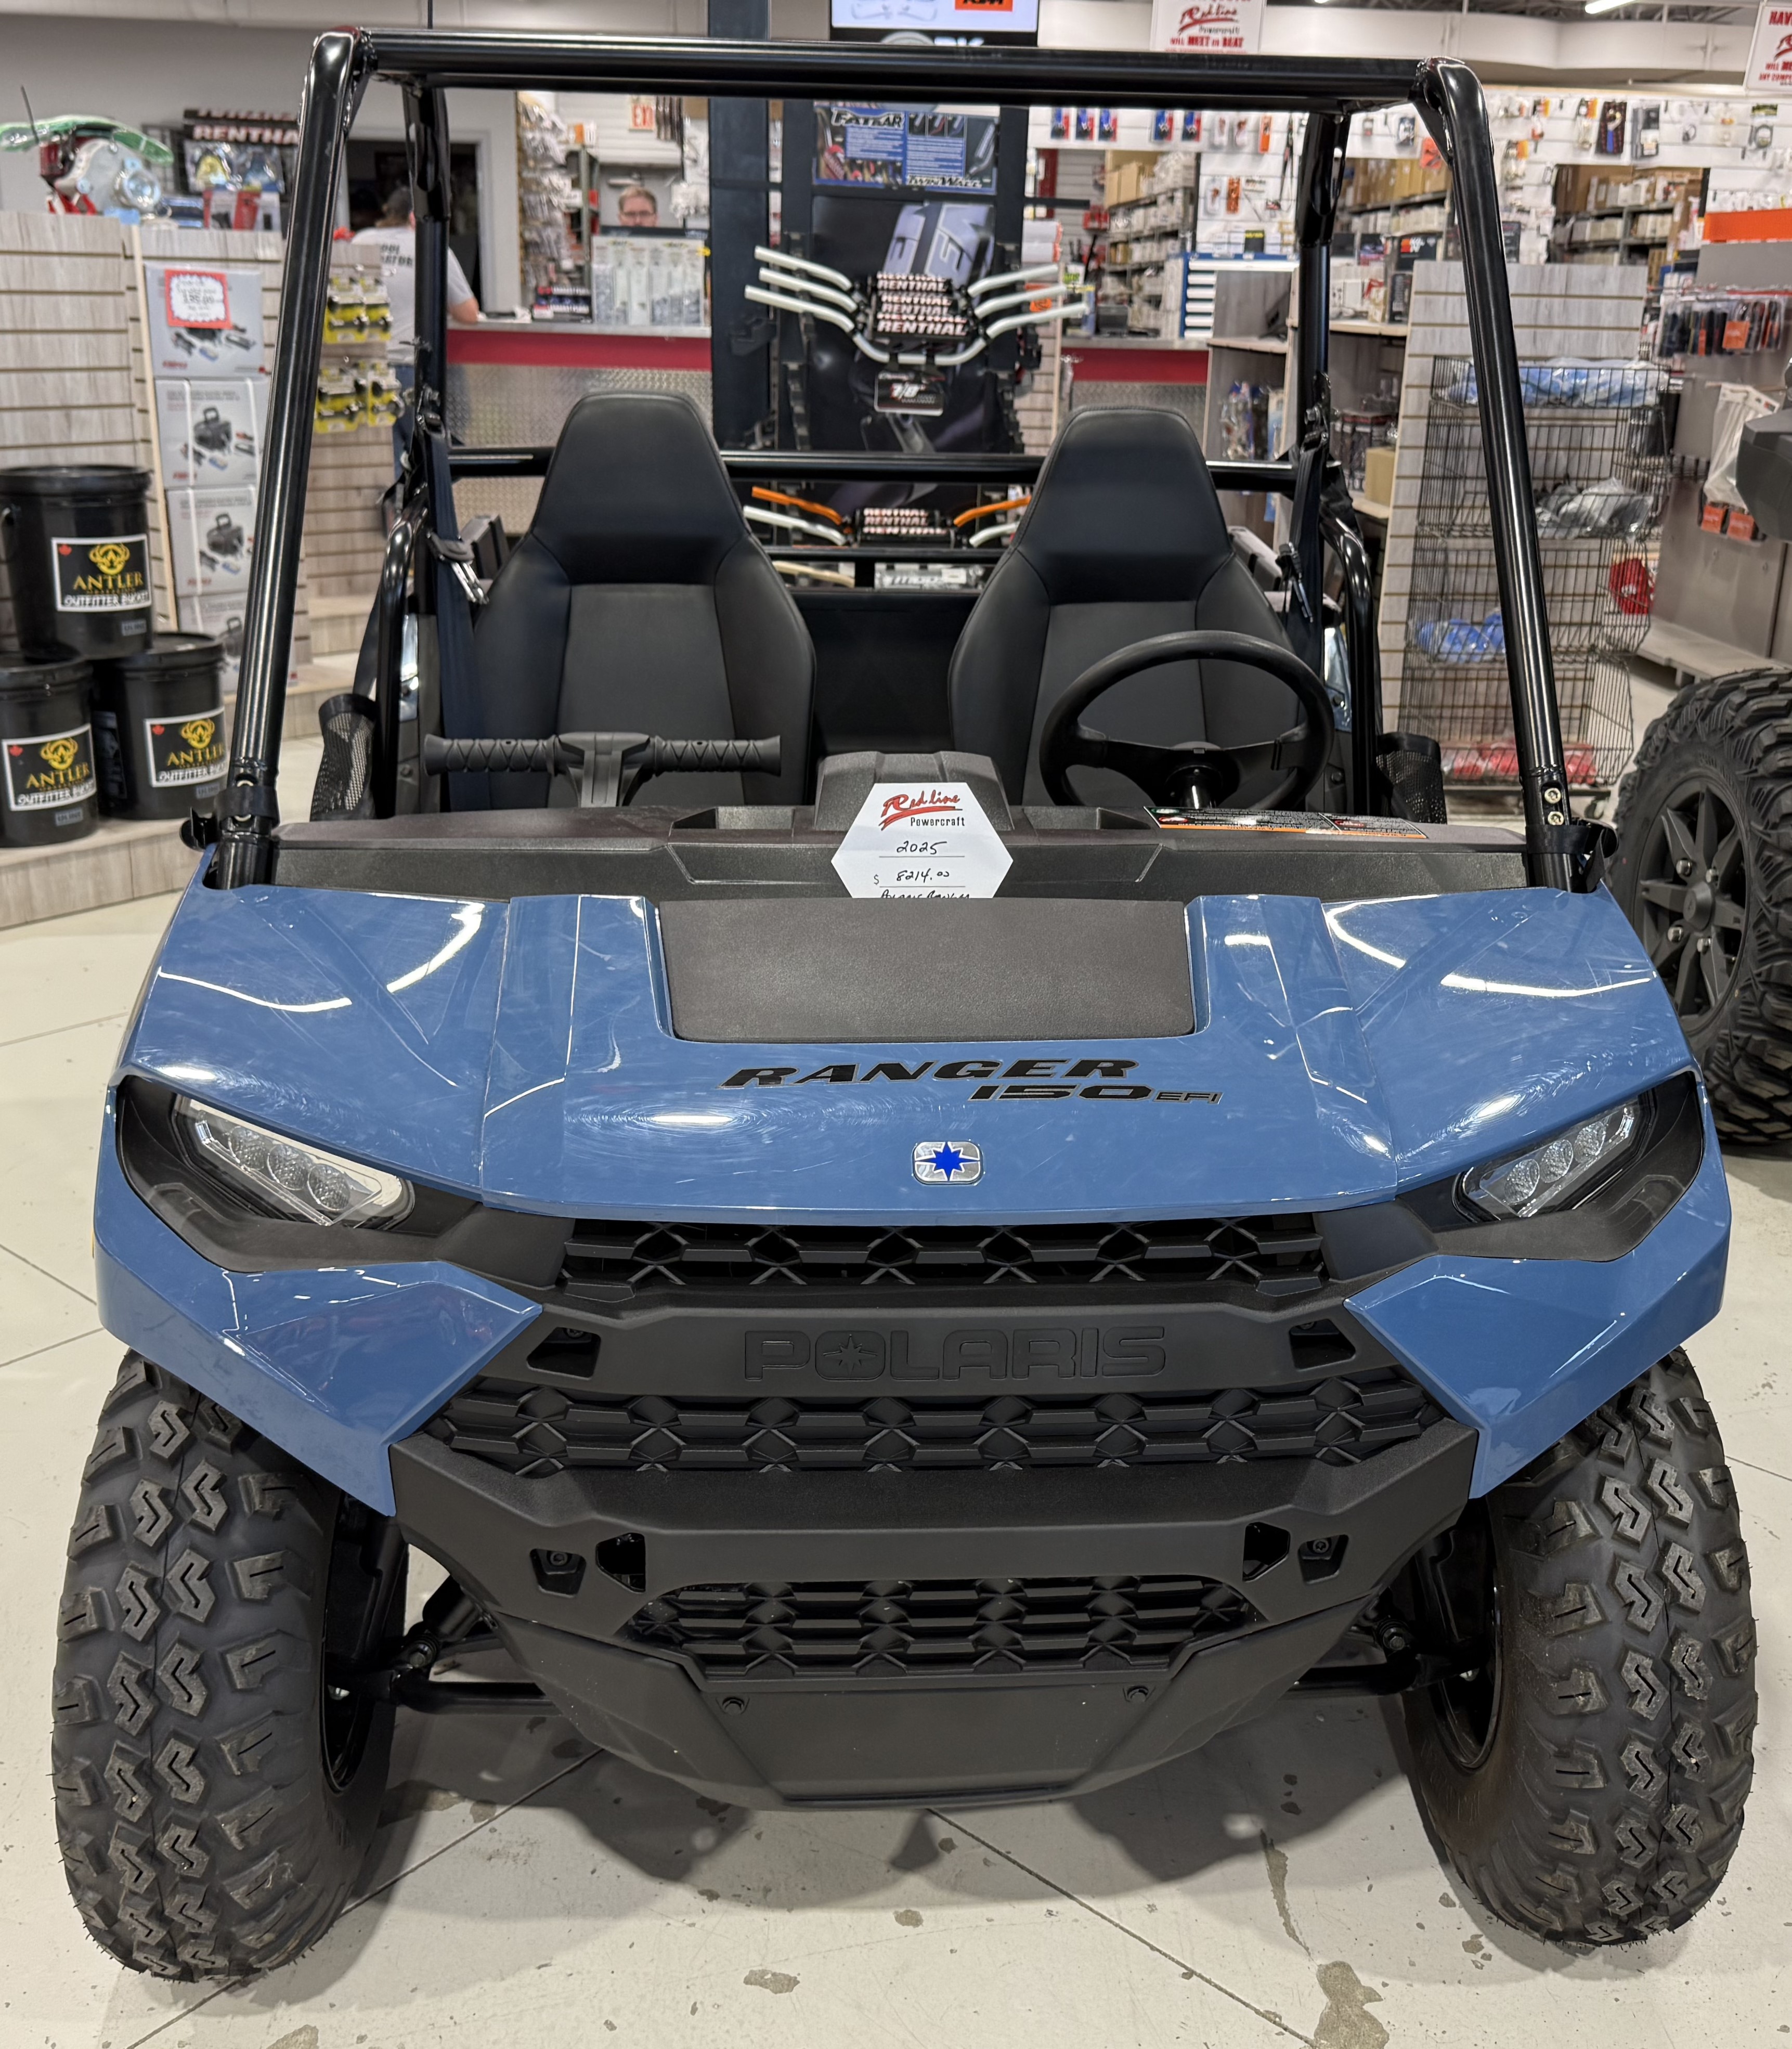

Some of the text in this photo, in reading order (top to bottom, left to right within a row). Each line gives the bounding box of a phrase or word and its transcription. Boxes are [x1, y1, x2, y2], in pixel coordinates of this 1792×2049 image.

[1769, 11, 1792, 25] HAV
[877, 280, 948, 292] RENTHAL
[877, 320, 967, 336] RENTHAL
[73, 572, 144, 590] ANTLER
[27, 762, 90, 789] ANTLER
[911, 816, 965, 826] Powercraft
[897, 840, 947, 855] 2025
[873, 874, 880, 885] $
[717, 1058, 1141, 1090] RANGER
[967, 1083, 1224, 1105] 150 EFI
[744, 1326, 1166, 1381] POLARIS
